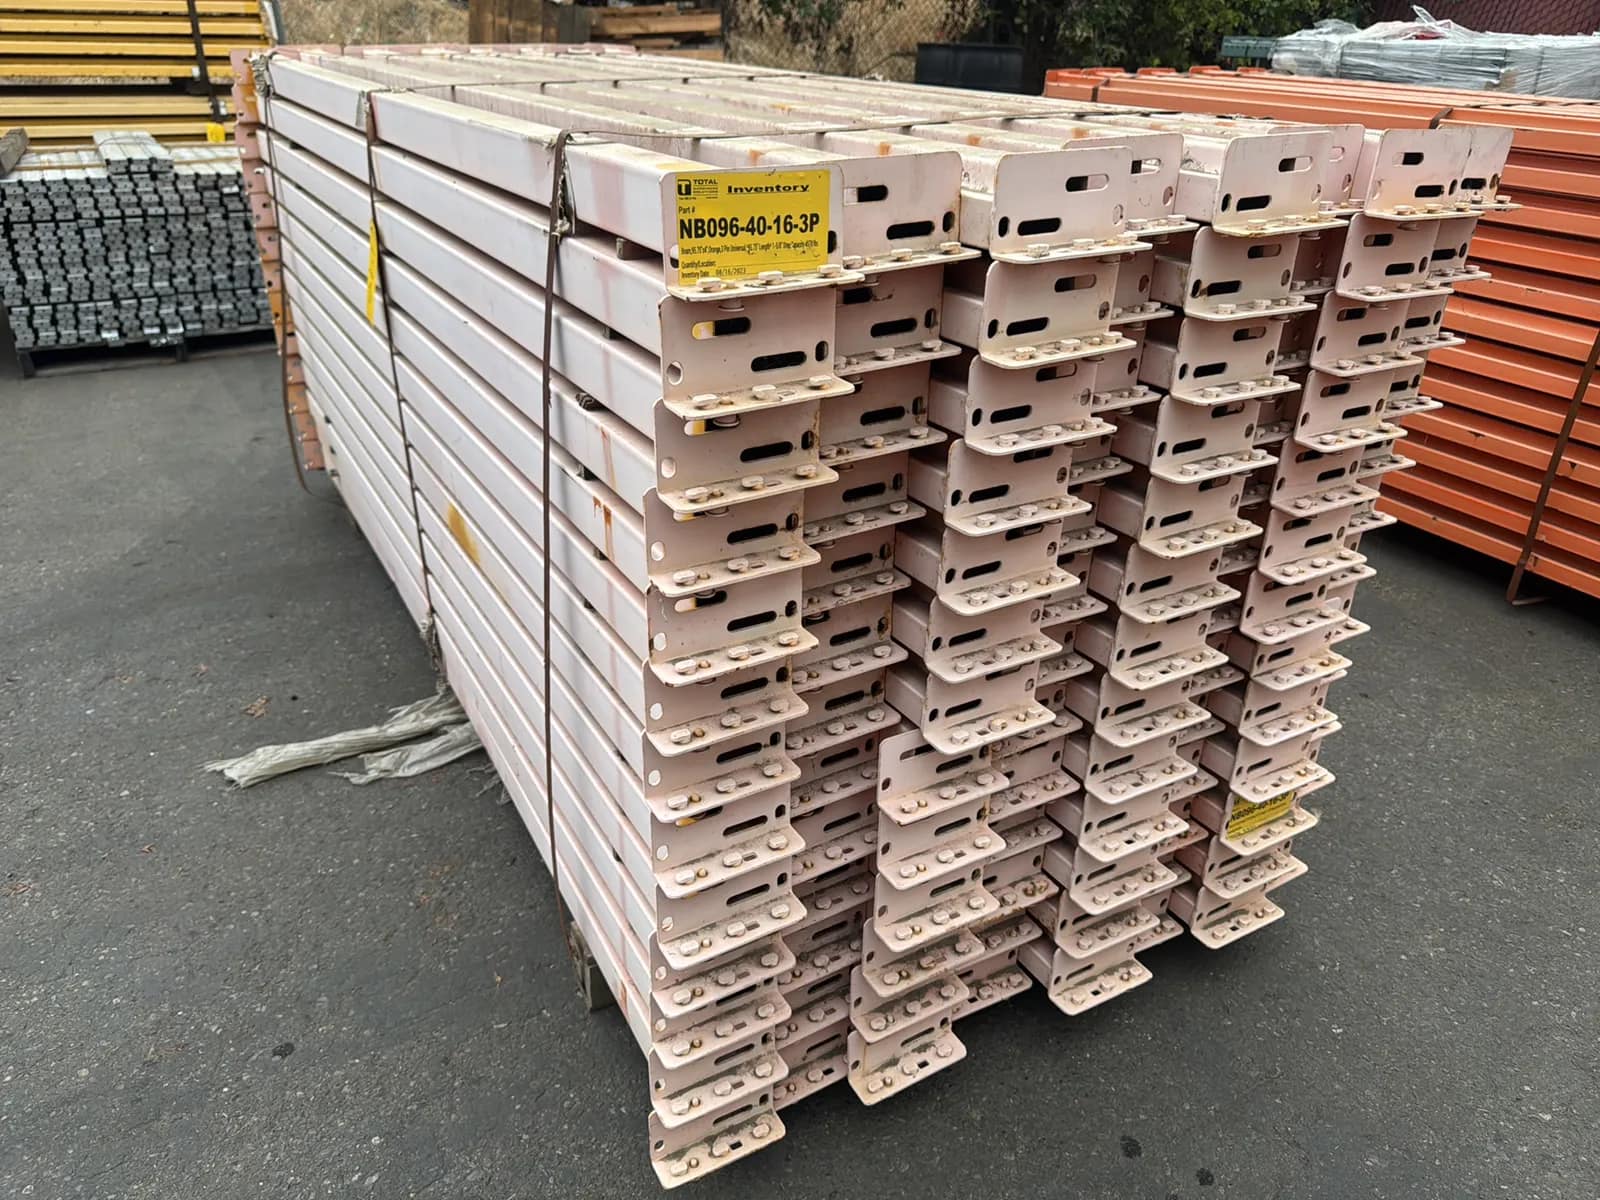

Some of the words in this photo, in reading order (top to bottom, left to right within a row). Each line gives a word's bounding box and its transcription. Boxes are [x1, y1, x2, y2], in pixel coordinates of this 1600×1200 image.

[727, 184, 809, 194] Inventory
[678, 206, 690, 214] Part
[680, 213, 820, 239] NB096-40-16-3P
